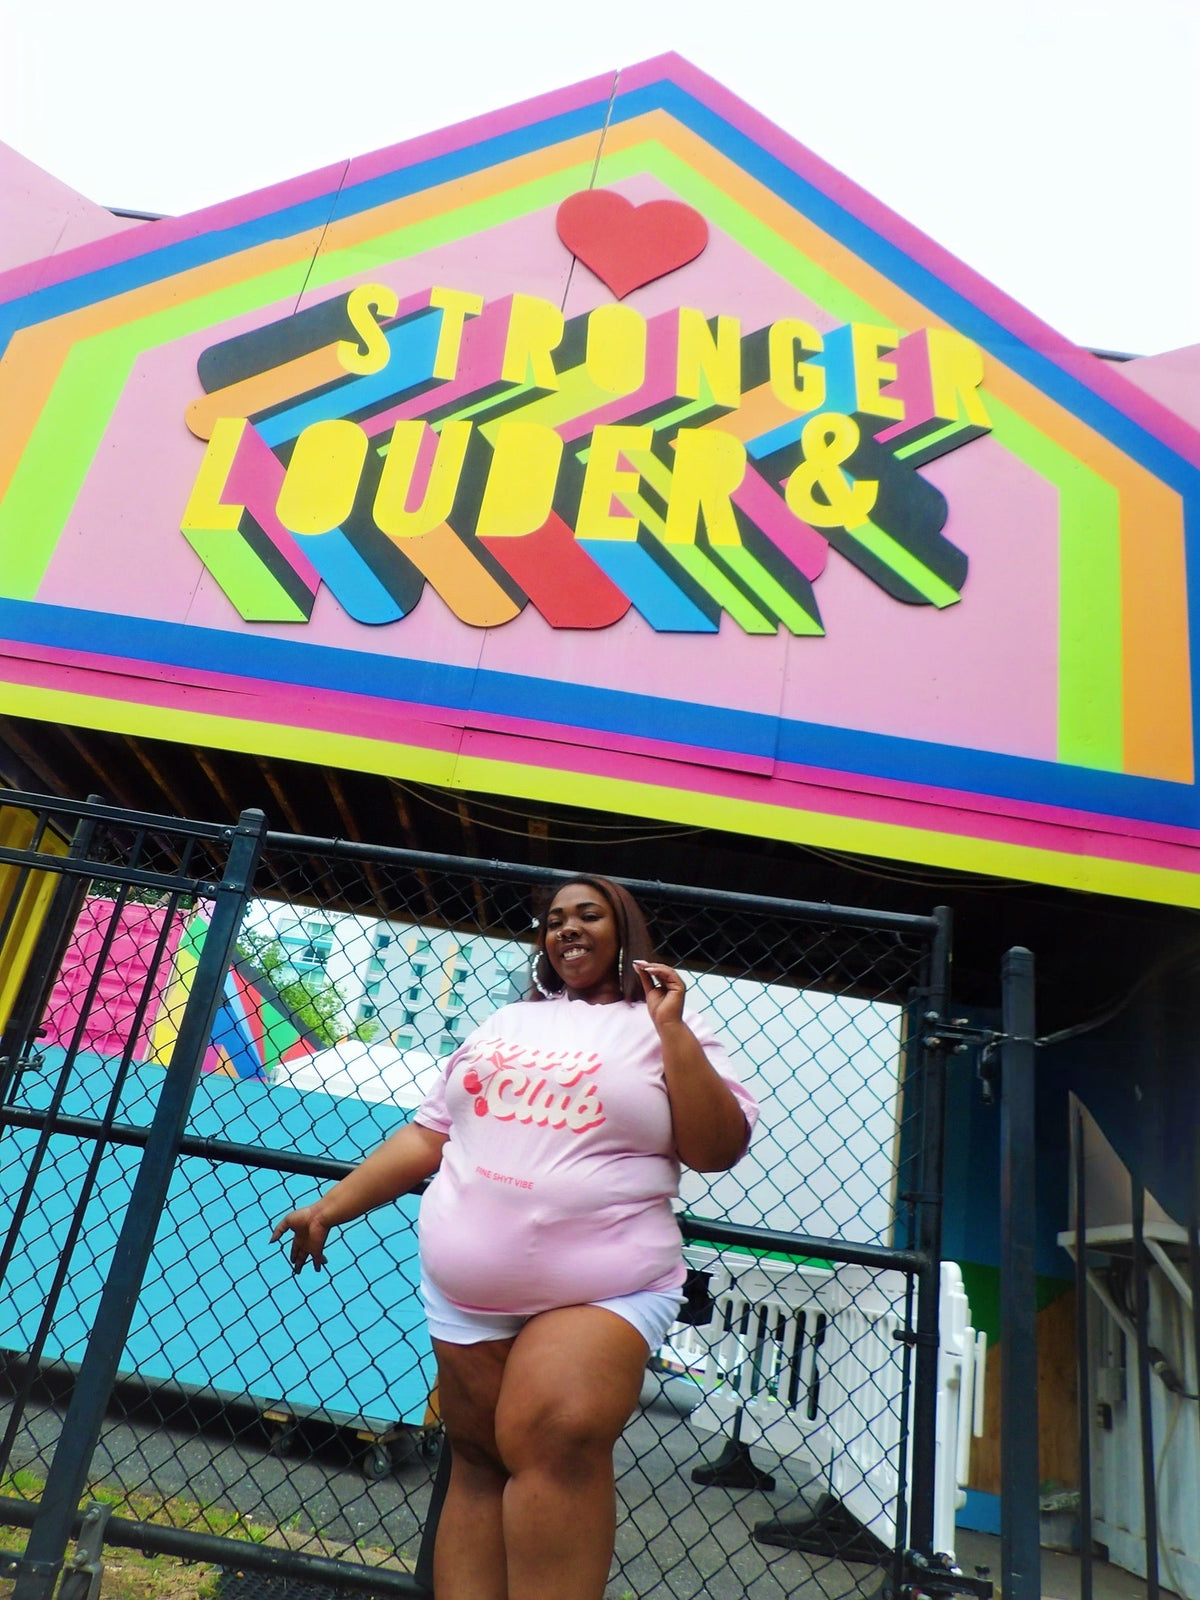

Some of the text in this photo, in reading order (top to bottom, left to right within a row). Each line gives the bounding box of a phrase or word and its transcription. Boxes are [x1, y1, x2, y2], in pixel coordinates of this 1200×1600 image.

[336, 284, 991, 430] STRONGER
[180, 413, 880, 547] LOUDER &
[487, 1068, 607, 1134] Club
[493, 1172, 514, 1185] SHYT
[514, 1178, 534, 1190] VIBE
